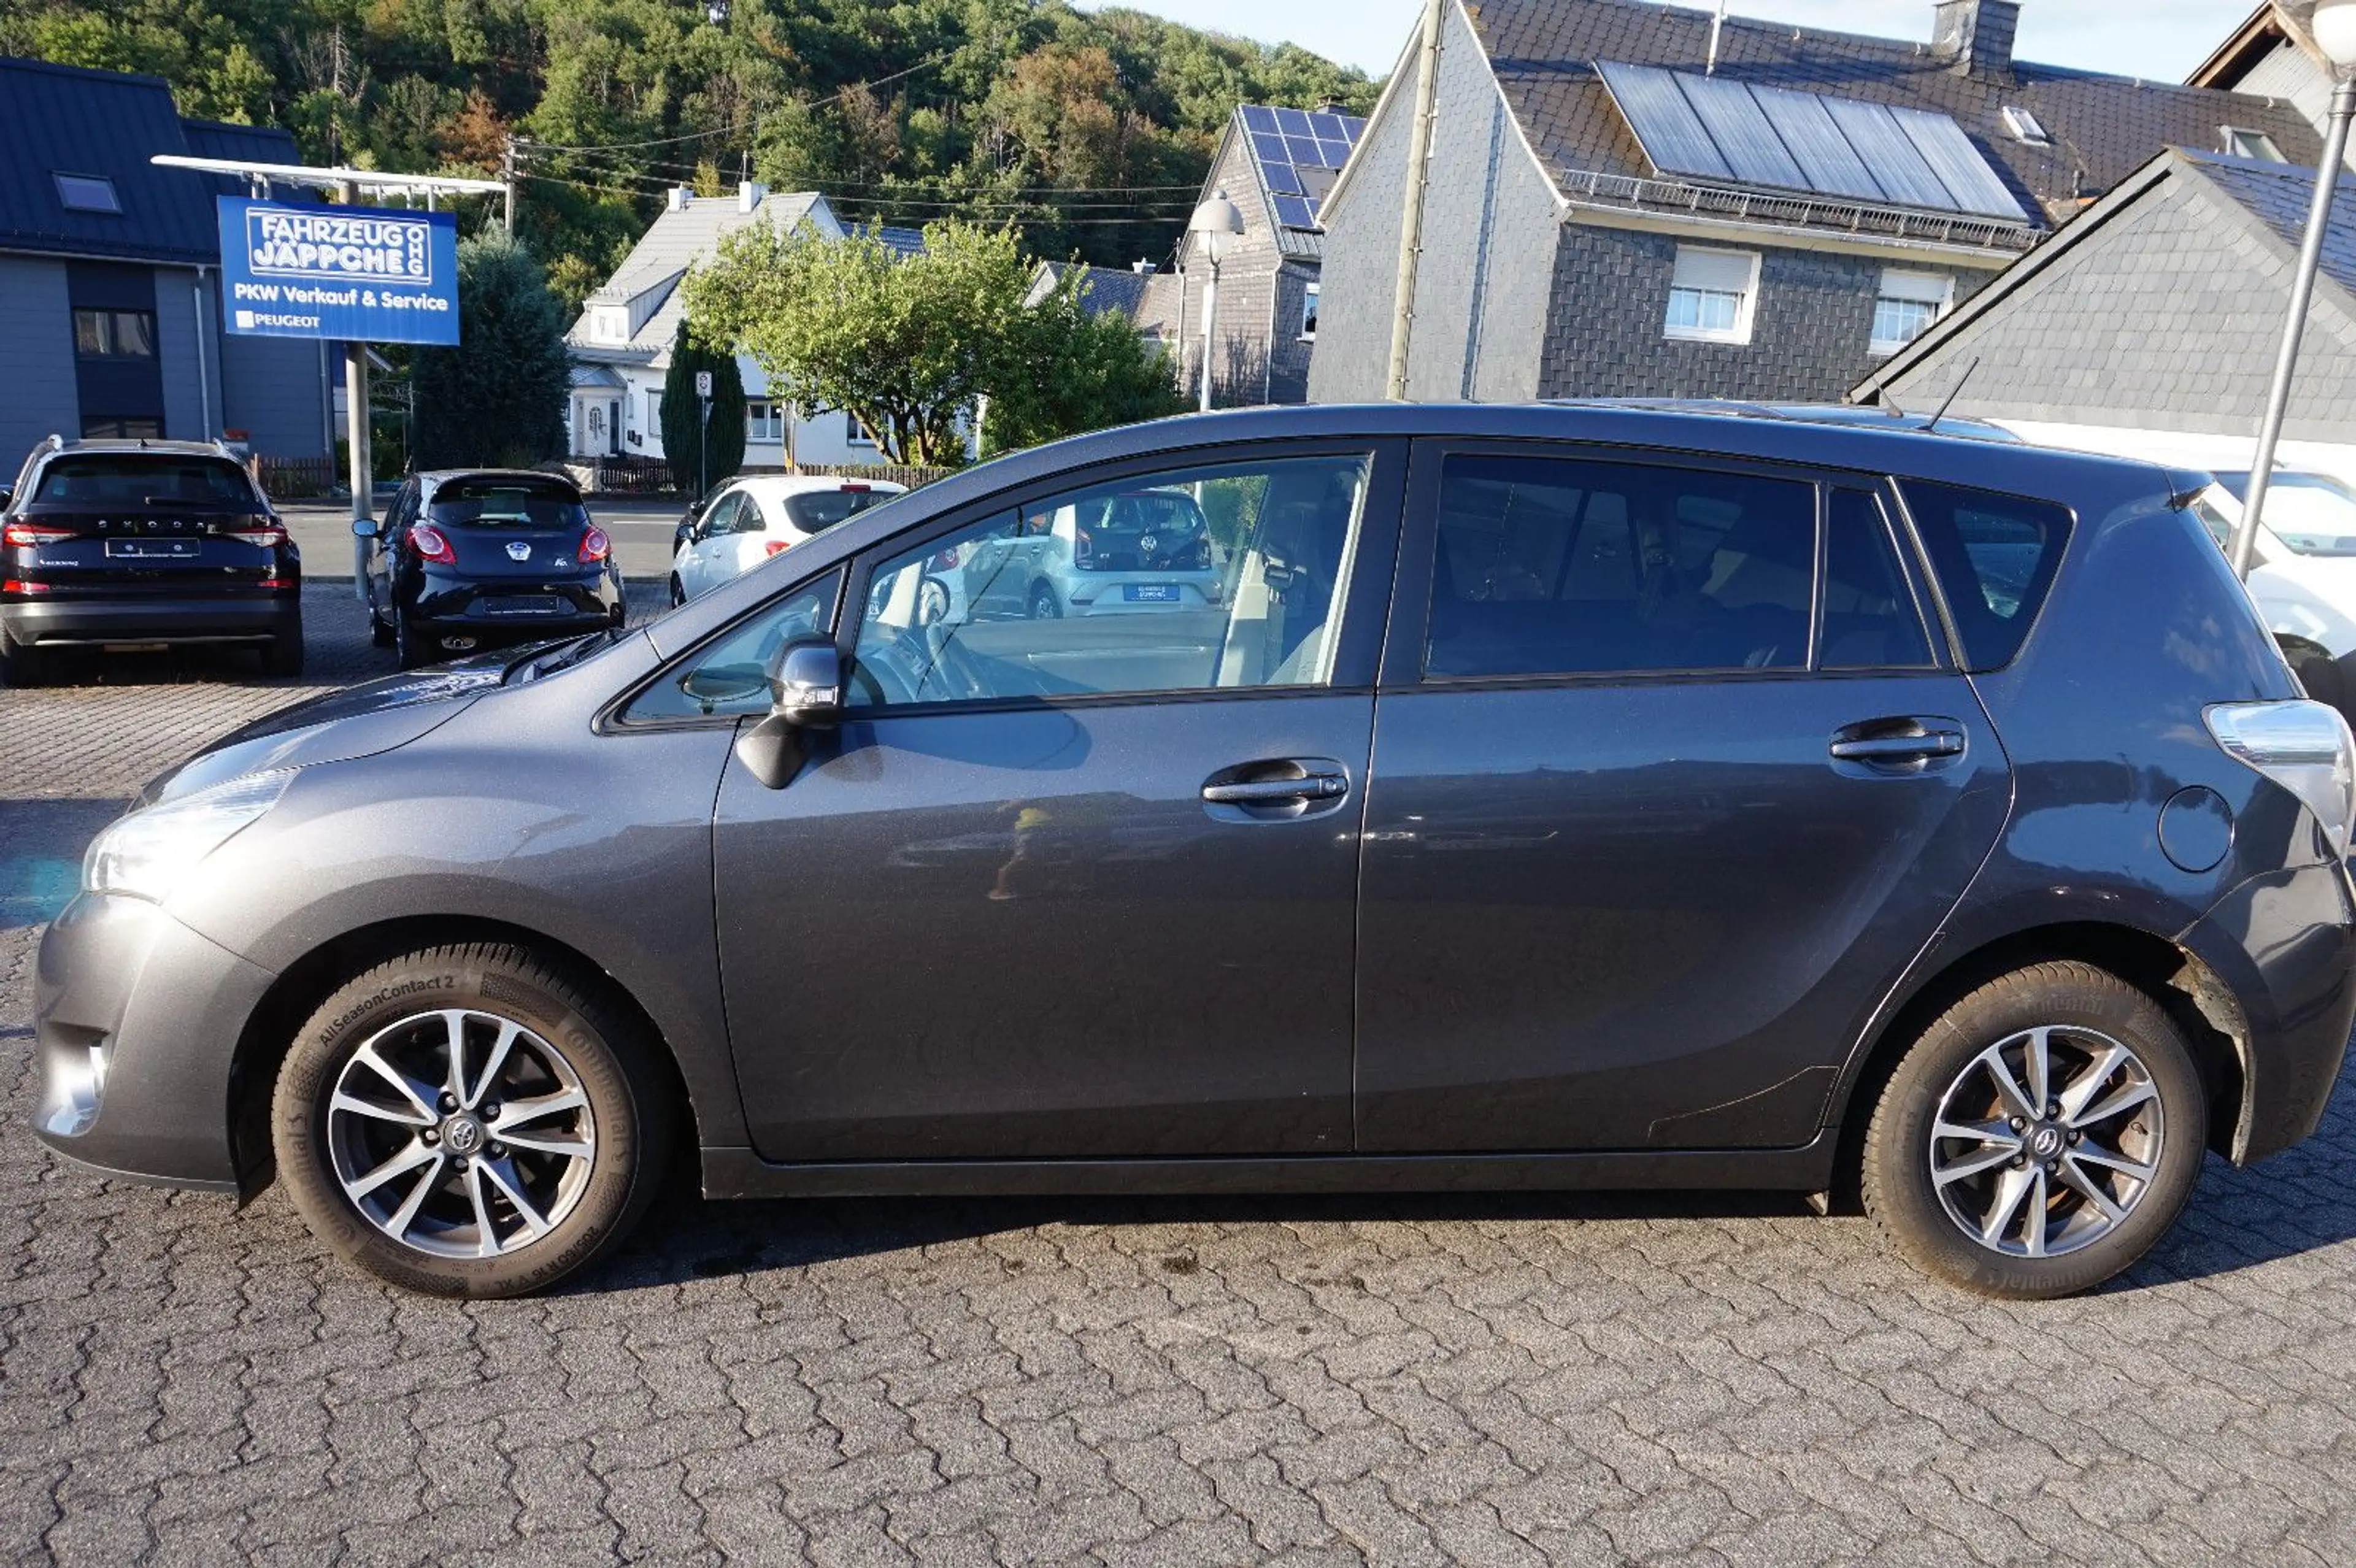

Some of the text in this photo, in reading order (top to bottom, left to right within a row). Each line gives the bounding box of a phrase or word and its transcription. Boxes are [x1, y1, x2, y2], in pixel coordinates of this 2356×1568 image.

[261, 216, 404, 247] FAHRZEUG
[253, 238, 404, 274] JÄPPCHE
[406, 226, 425, 275] OHG
[234, 283, 448, 311] PKW Verkauf & Service
[254, 313, 321, 328] PEUGEOT
[318, 975, 455, 1047] AllSeasonContact 2
